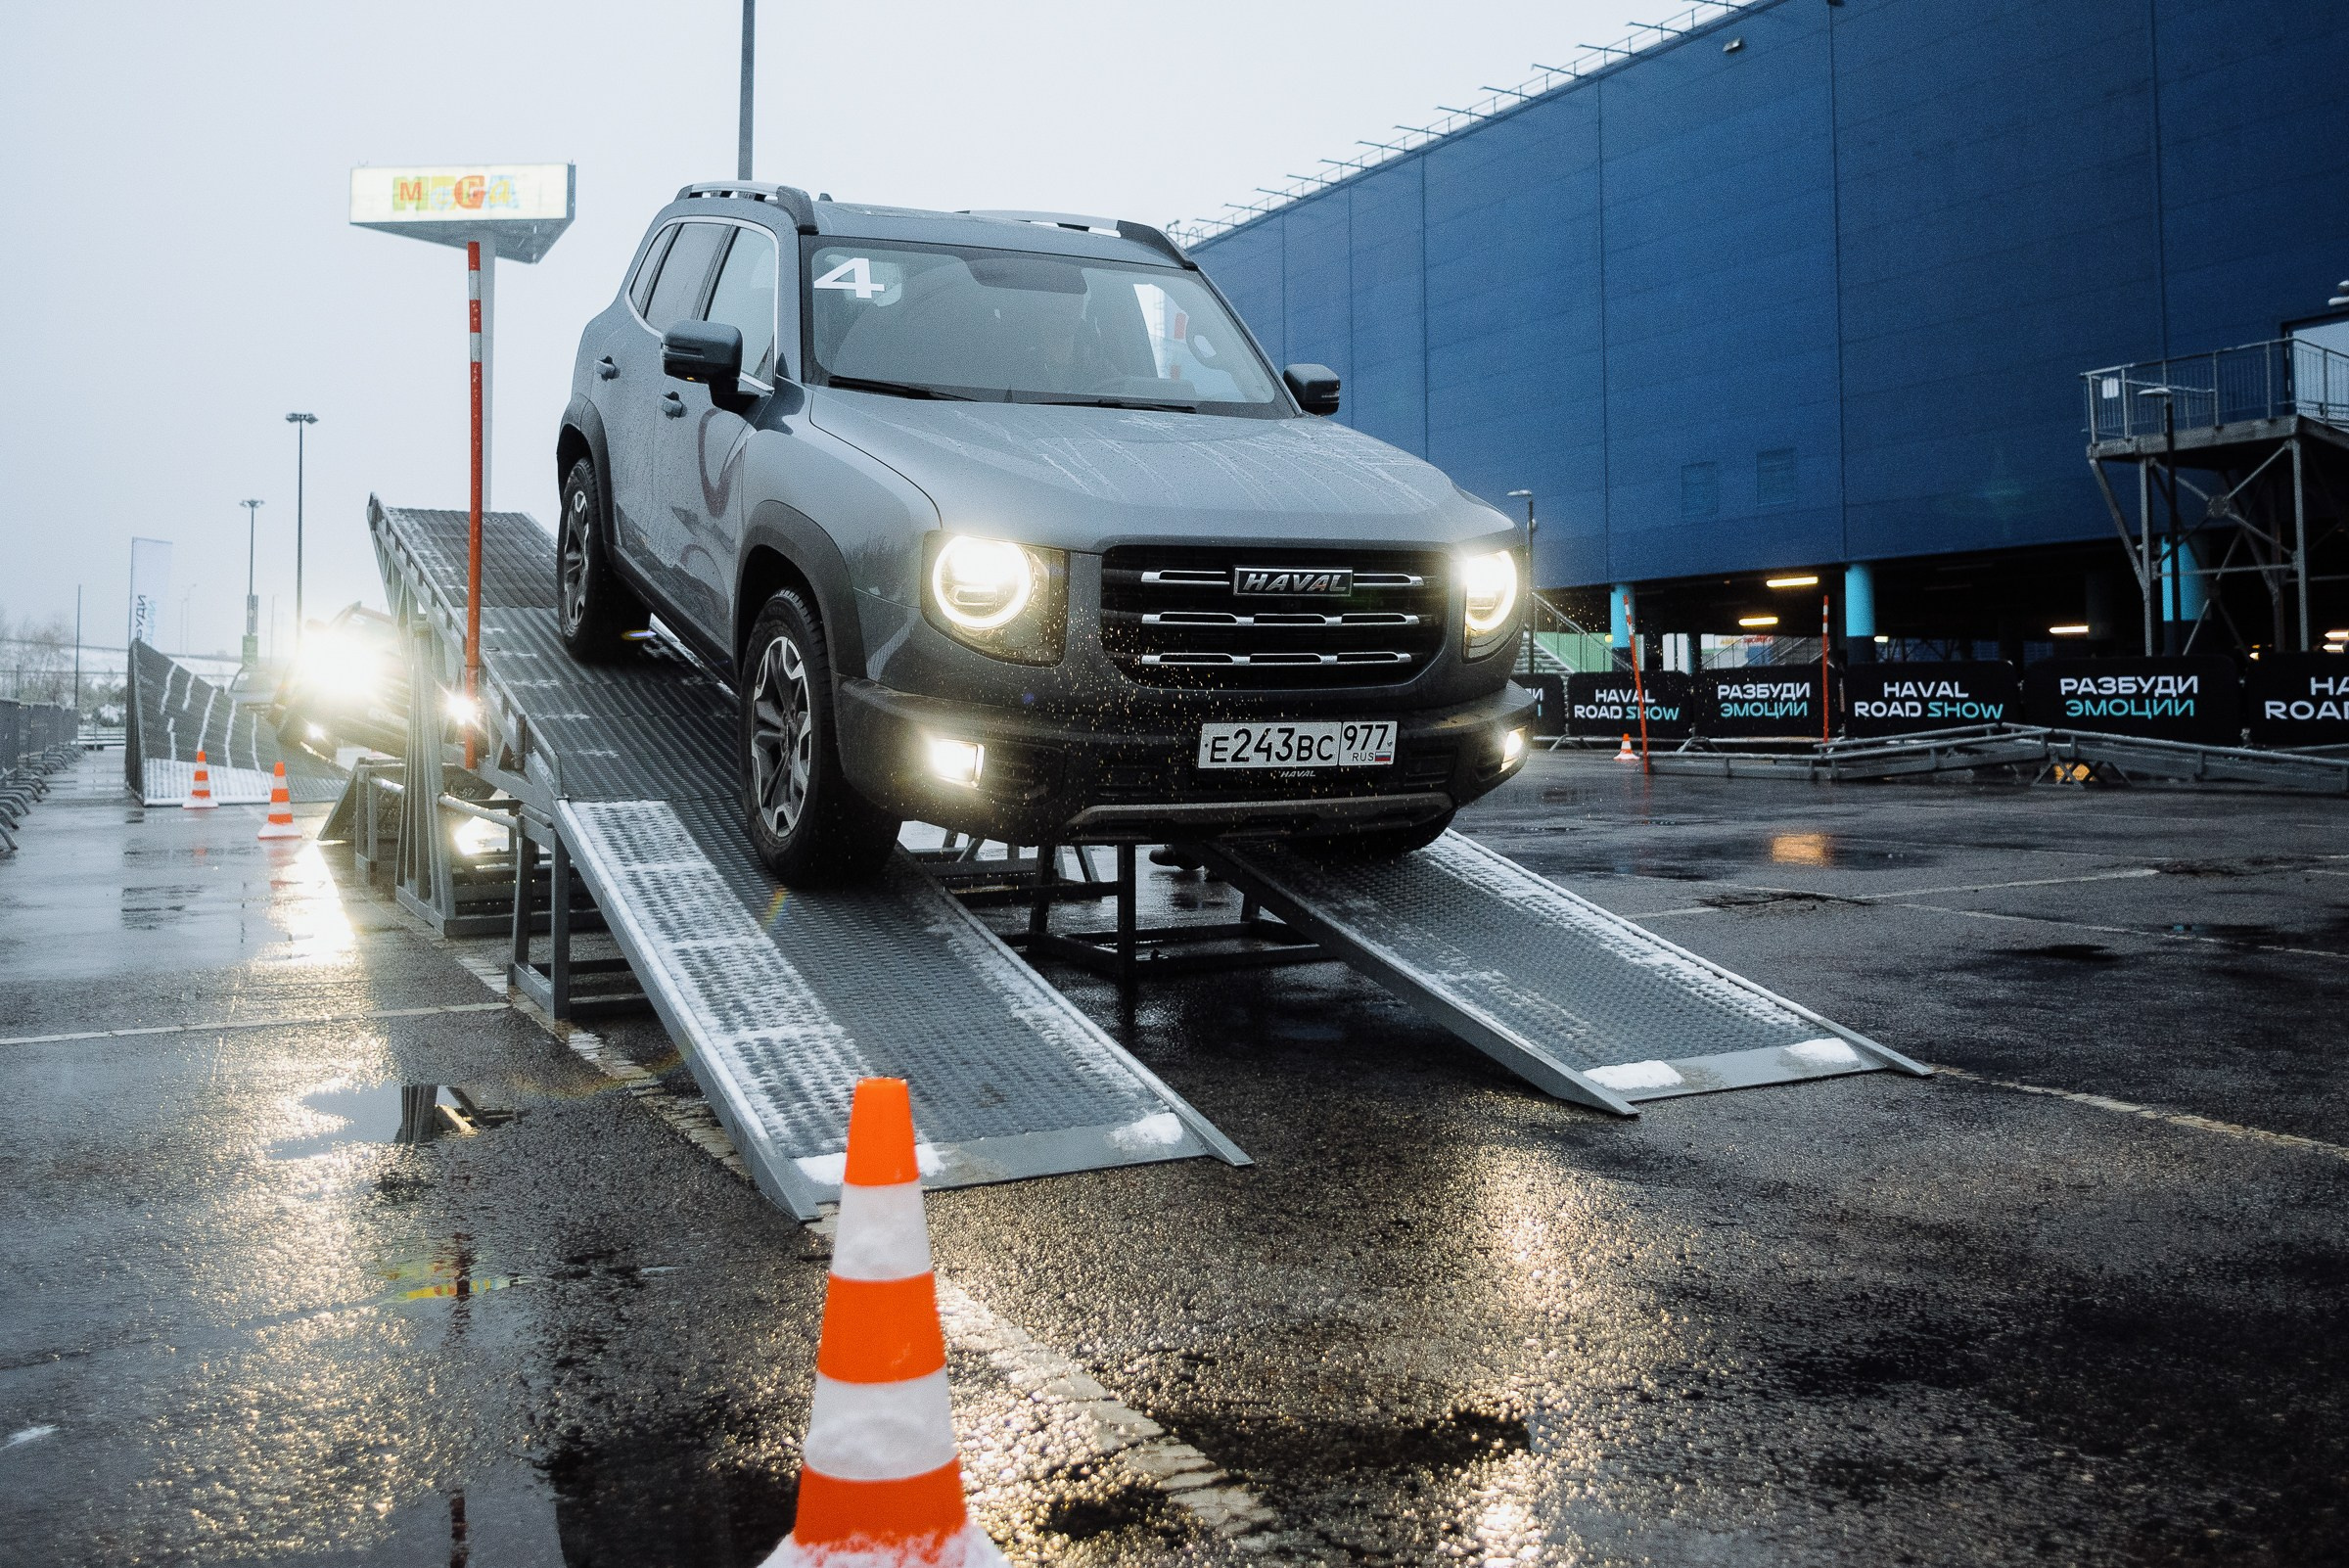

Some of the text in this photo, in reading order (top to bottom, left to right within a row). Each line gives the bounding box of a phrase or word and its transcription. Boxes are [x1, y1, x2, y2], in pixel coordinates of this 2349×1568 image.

[813, 257, 886, 299] 4
[1242, 573, 1348, 591] HAVAL
[1717, 682, 1811, 701] РАЗБУДИ
[1883, 681, 1969, 698] HAVAL
[2059, 675, 2198, 698] РАЗБУДИ
[1574, 705, 1623, 719] ROAD
[1720, 701, 1808, 719] ЭМОЦИИ
[1854, 701, 2004, 719] ROAD SHOW
[2065, 698, 2194, 720] ЭМОЦИИ
[2265, 700, 2349, 720] ROA
[1343, 724, 1390, 752] 977
[1352, 753, 1374, 762] RUS
